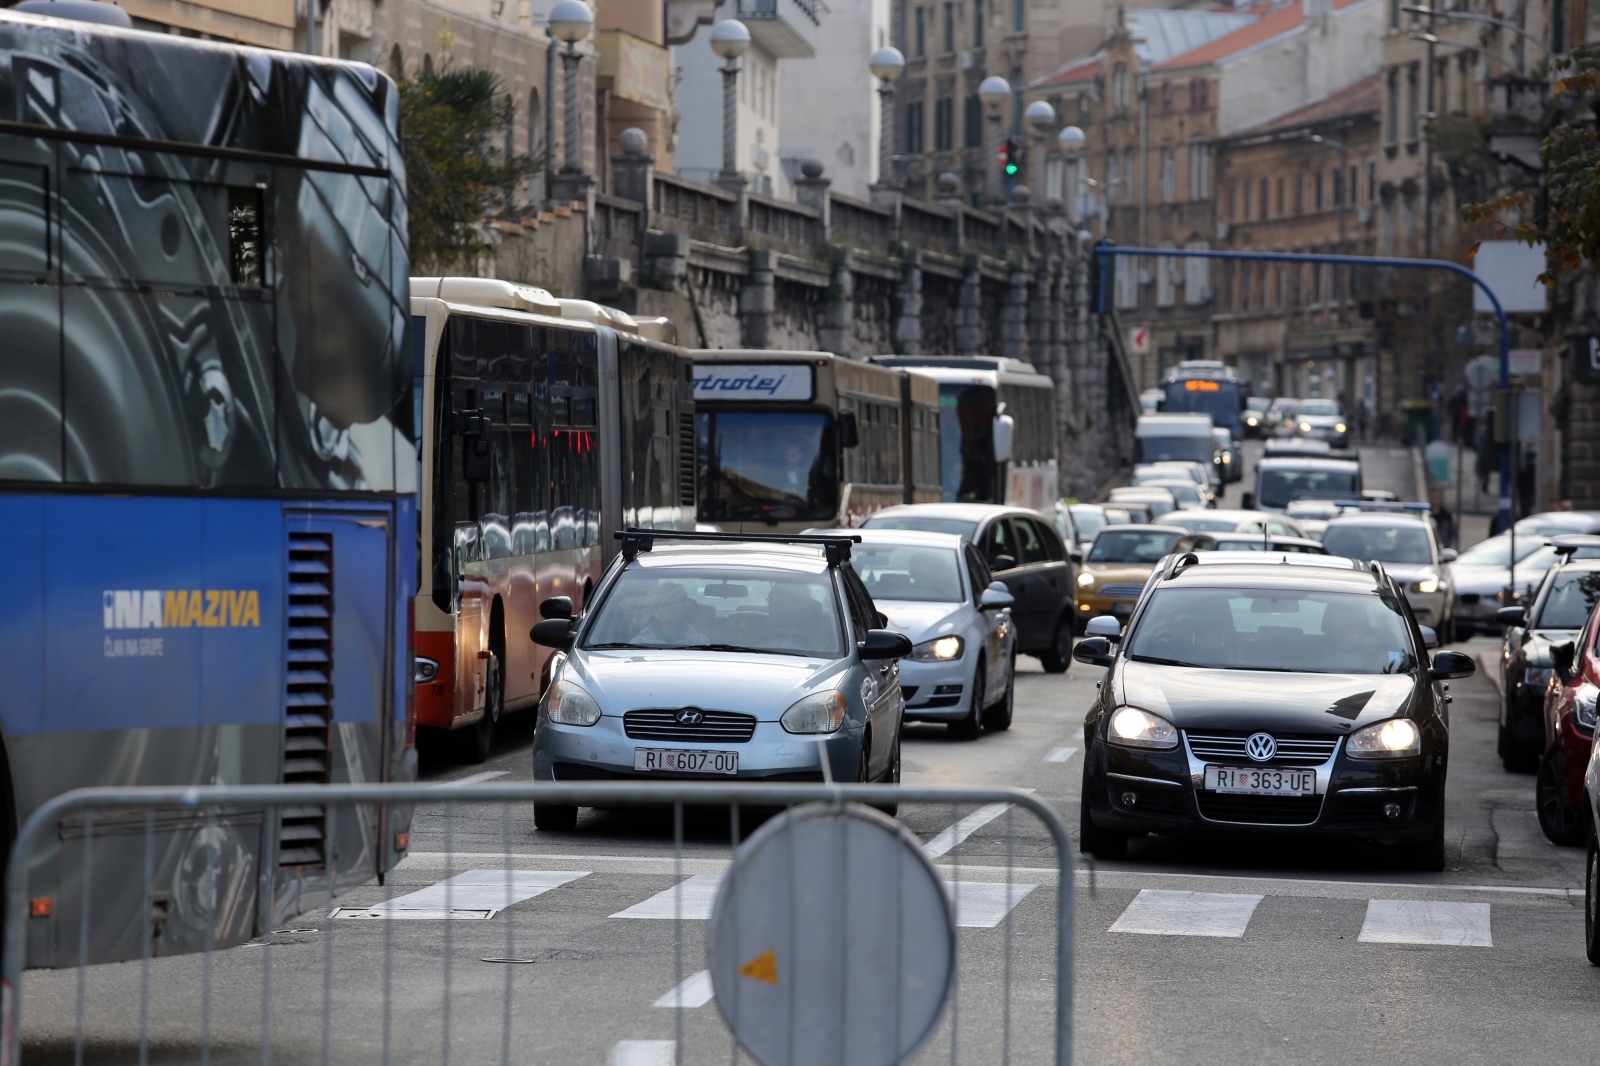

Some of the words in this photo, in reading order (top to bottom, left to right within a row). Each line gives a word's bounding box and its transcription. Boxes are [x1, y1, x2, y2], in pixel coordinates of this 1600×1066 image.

[162, 589, 260, 628] MAZIVA
[646, 752, 662, 768] RI
[677, 753, 735, 771] 607-OU
[1217, 771, 1235, 787] RI
[1250, 772, 1311, 791] 363-UE
